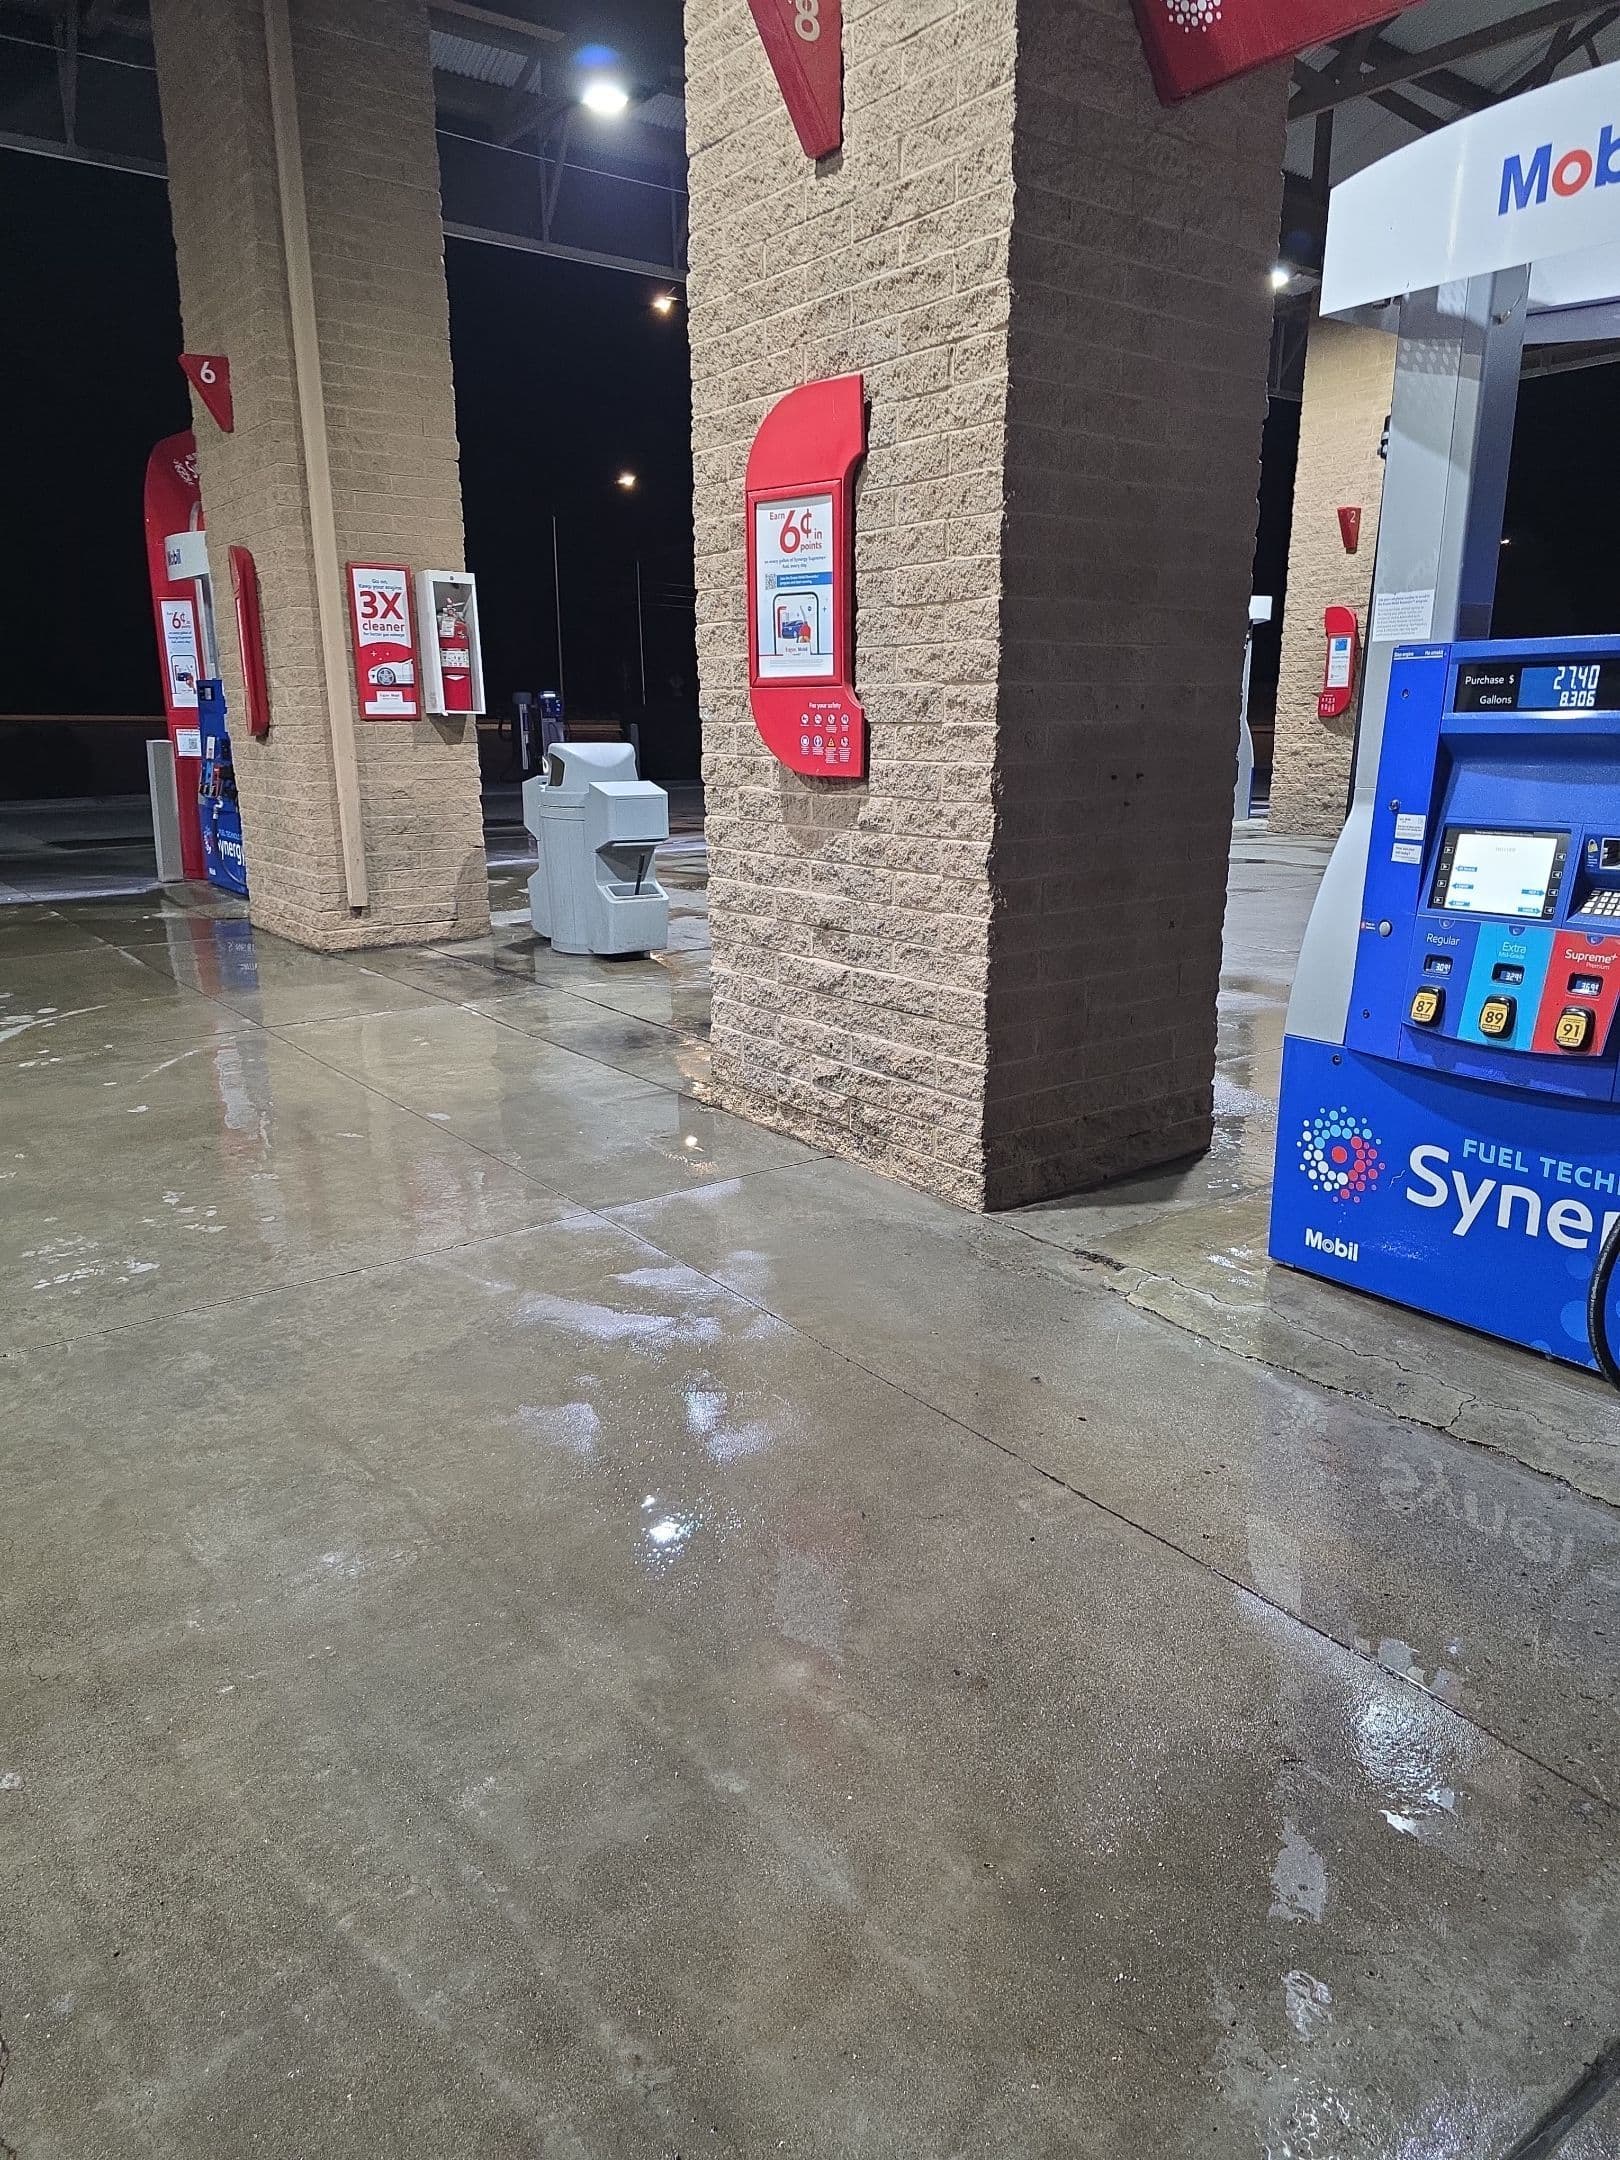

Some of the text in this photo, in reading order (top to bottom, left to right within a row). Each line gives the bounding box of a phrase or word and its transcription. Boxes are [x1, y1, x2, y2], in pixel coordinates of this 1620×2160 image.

[200, 361, 216, 384] 6
[1350, 510, 1356, 523] 2
[769, 508, 823, 553] Earn 6¢ in
[800, 541, 822, 553] points
[360, 590, 404, 620] 3X
[362, 620, 405, 632] cleaner
[1465, 674, 1515, 685] Purchase $
[1479, 695, 1512, 705] Gallons
[1426, 933, 1461, 946] Regular
[1502, 941, 1526, 954] Extra
[1564, 948, 1618, 964] Supreme+
[1585, 961, 1610, 970] Premium
[1416, 1000, 1434, 1013] 87
[1485, 1011, 1504, 1025] 89
[1563, 1023, 1580, 1037] 91
[1463, 1138, 1620, 1196] FUEL TECH
[1305, 1227, 1361, 1262] Mobil
